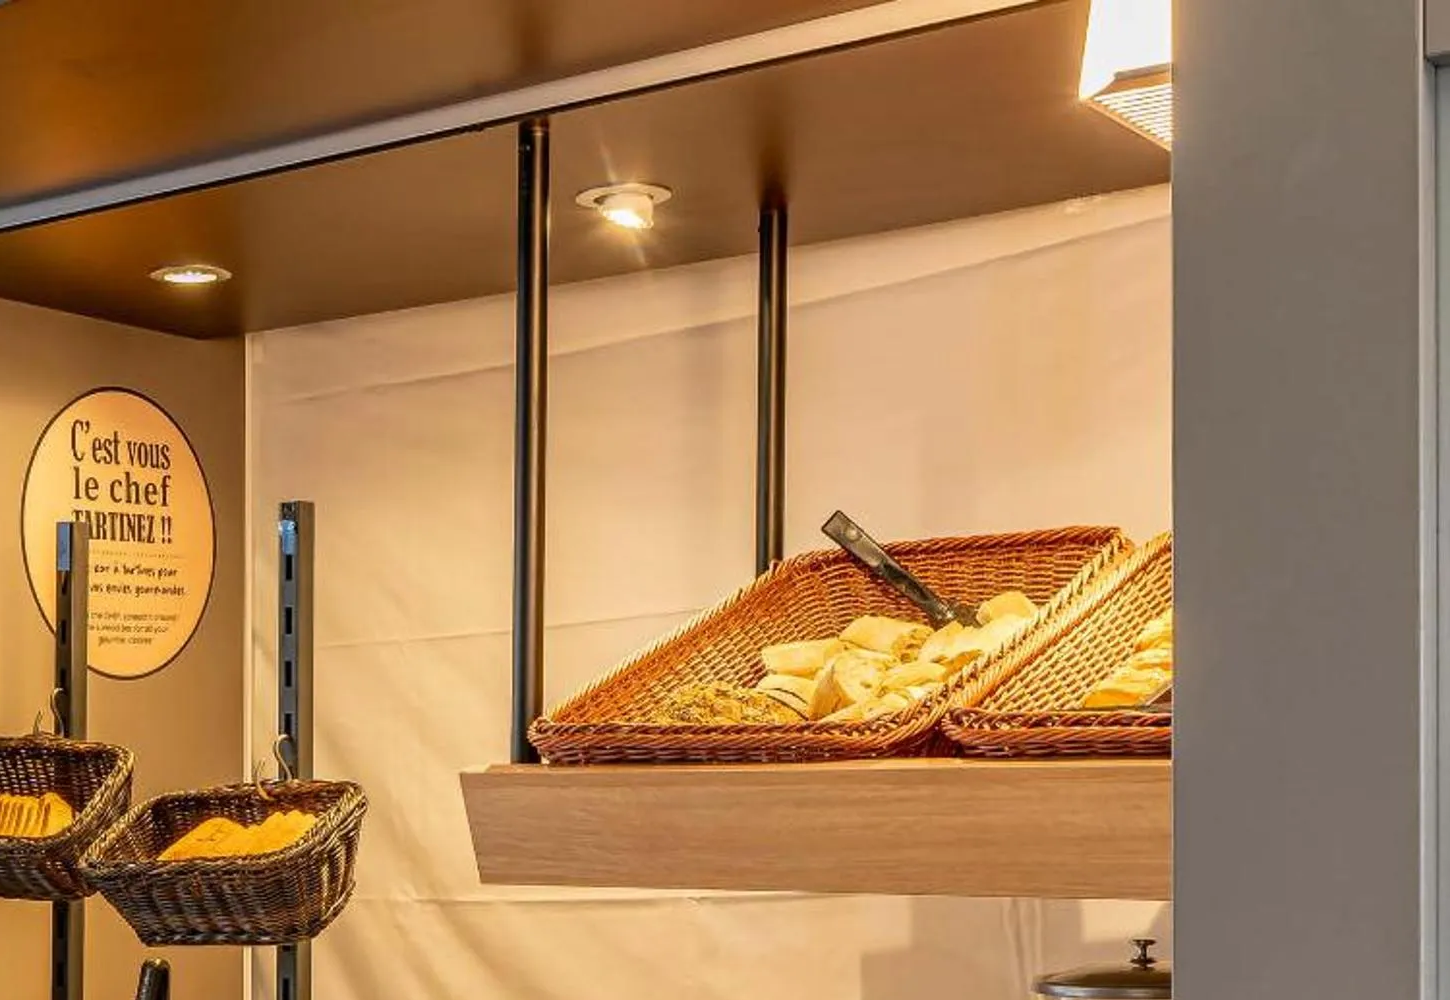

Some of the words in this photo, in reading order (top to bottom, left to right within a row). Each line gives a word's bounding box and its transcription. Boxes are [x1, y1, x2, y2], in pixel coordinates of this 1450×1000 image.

[70, 419, 120, 466] C'est
[126, 439, 172, 470] vous
[73, 466, 99, 501] le
[109, 471, 172, 507] chef
